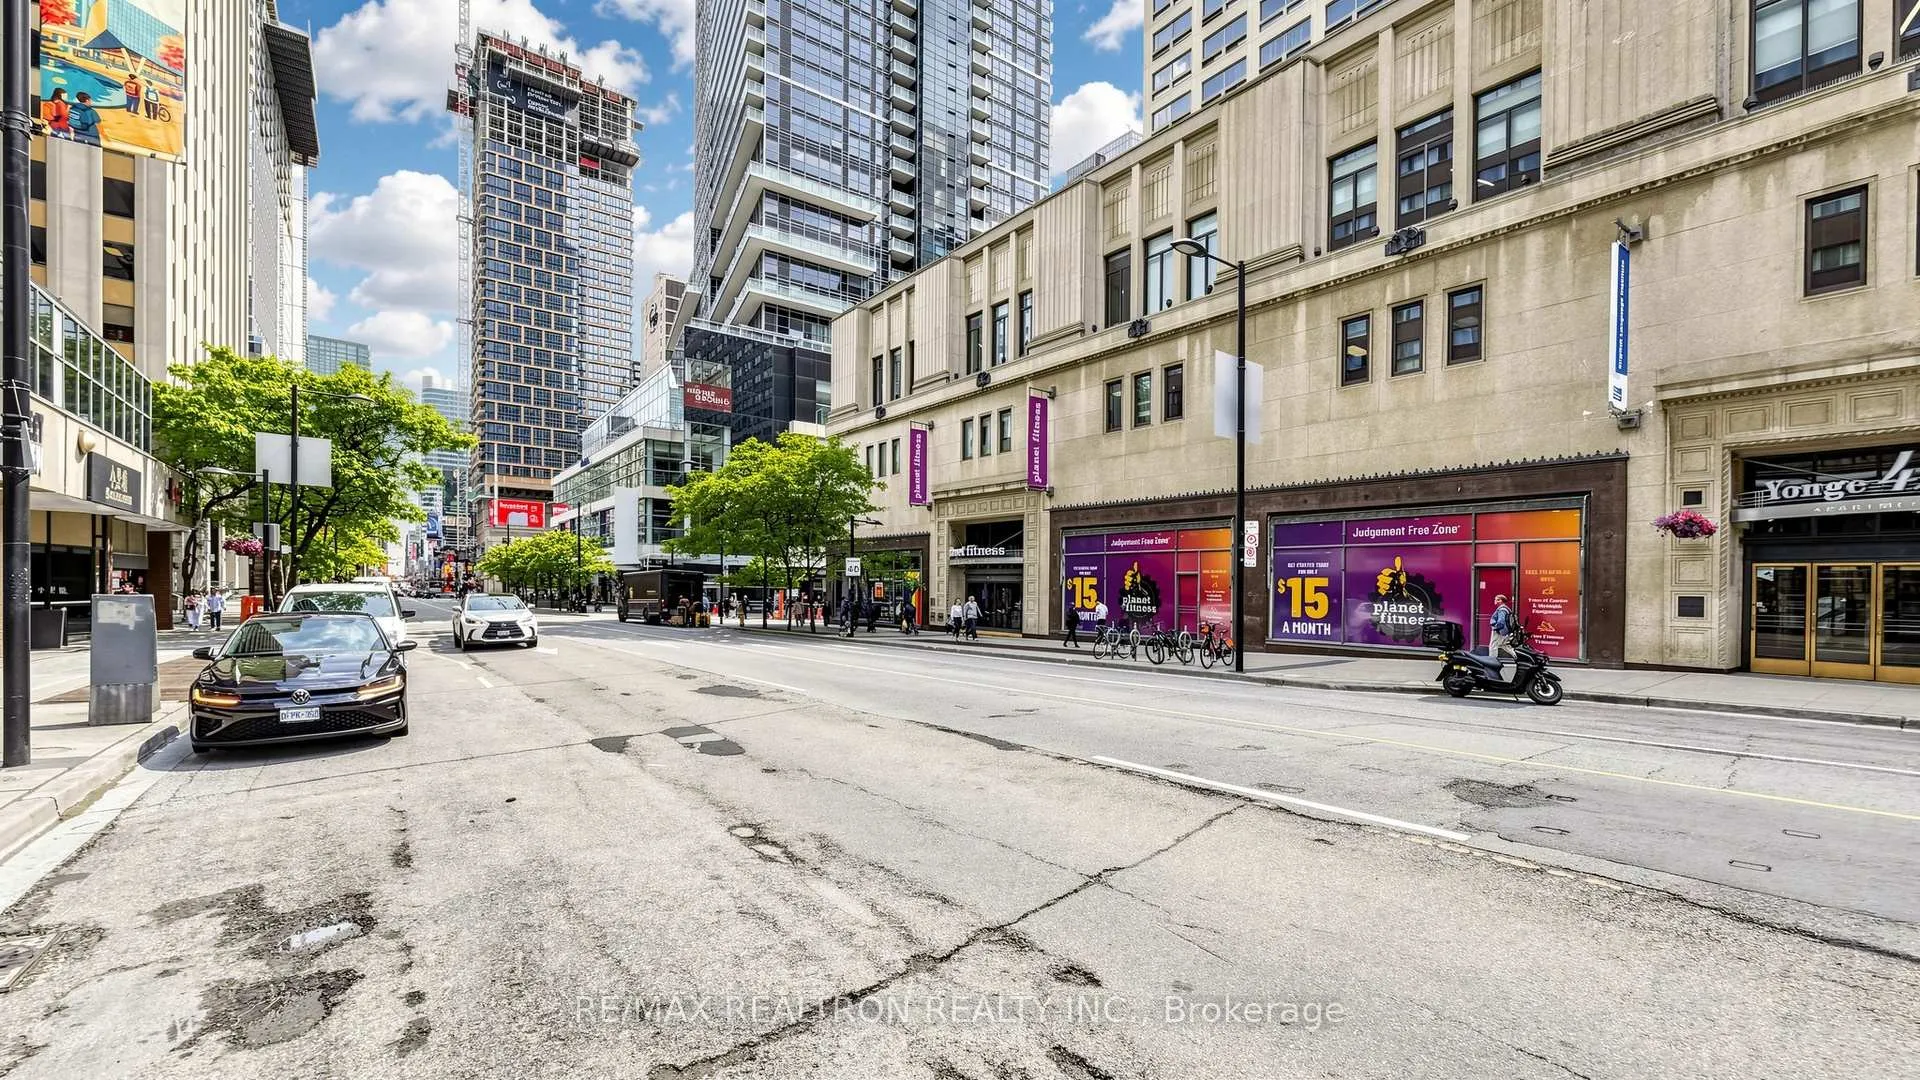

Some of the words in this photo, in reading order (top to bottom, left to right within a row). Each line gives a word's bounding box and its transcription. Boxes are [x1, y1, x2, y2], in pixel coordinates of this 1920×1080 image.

[1032, 402, 1041, 443] fitness
[1032, 447, 1042, 483] planet
[914, 469, 922, 499] planet
[1766, 479, 1866, 501] Yonge
[1353, 527, 1405, 539] Judgement
[1408, 525, 1430, 535] Free
[966, 544, 1005, 556] fitness
[1066, 577, 1098, 610] $15
[1122, 594, 1151, 606] planet
[1277, 577, 1329, 619] $15
[1125, 604, 1157, 613] fitness
[1373, 601, 1424, 615] planet
[1282, 620, 1290, 634] A
[1292, 621, 1332, 636] MONTH
